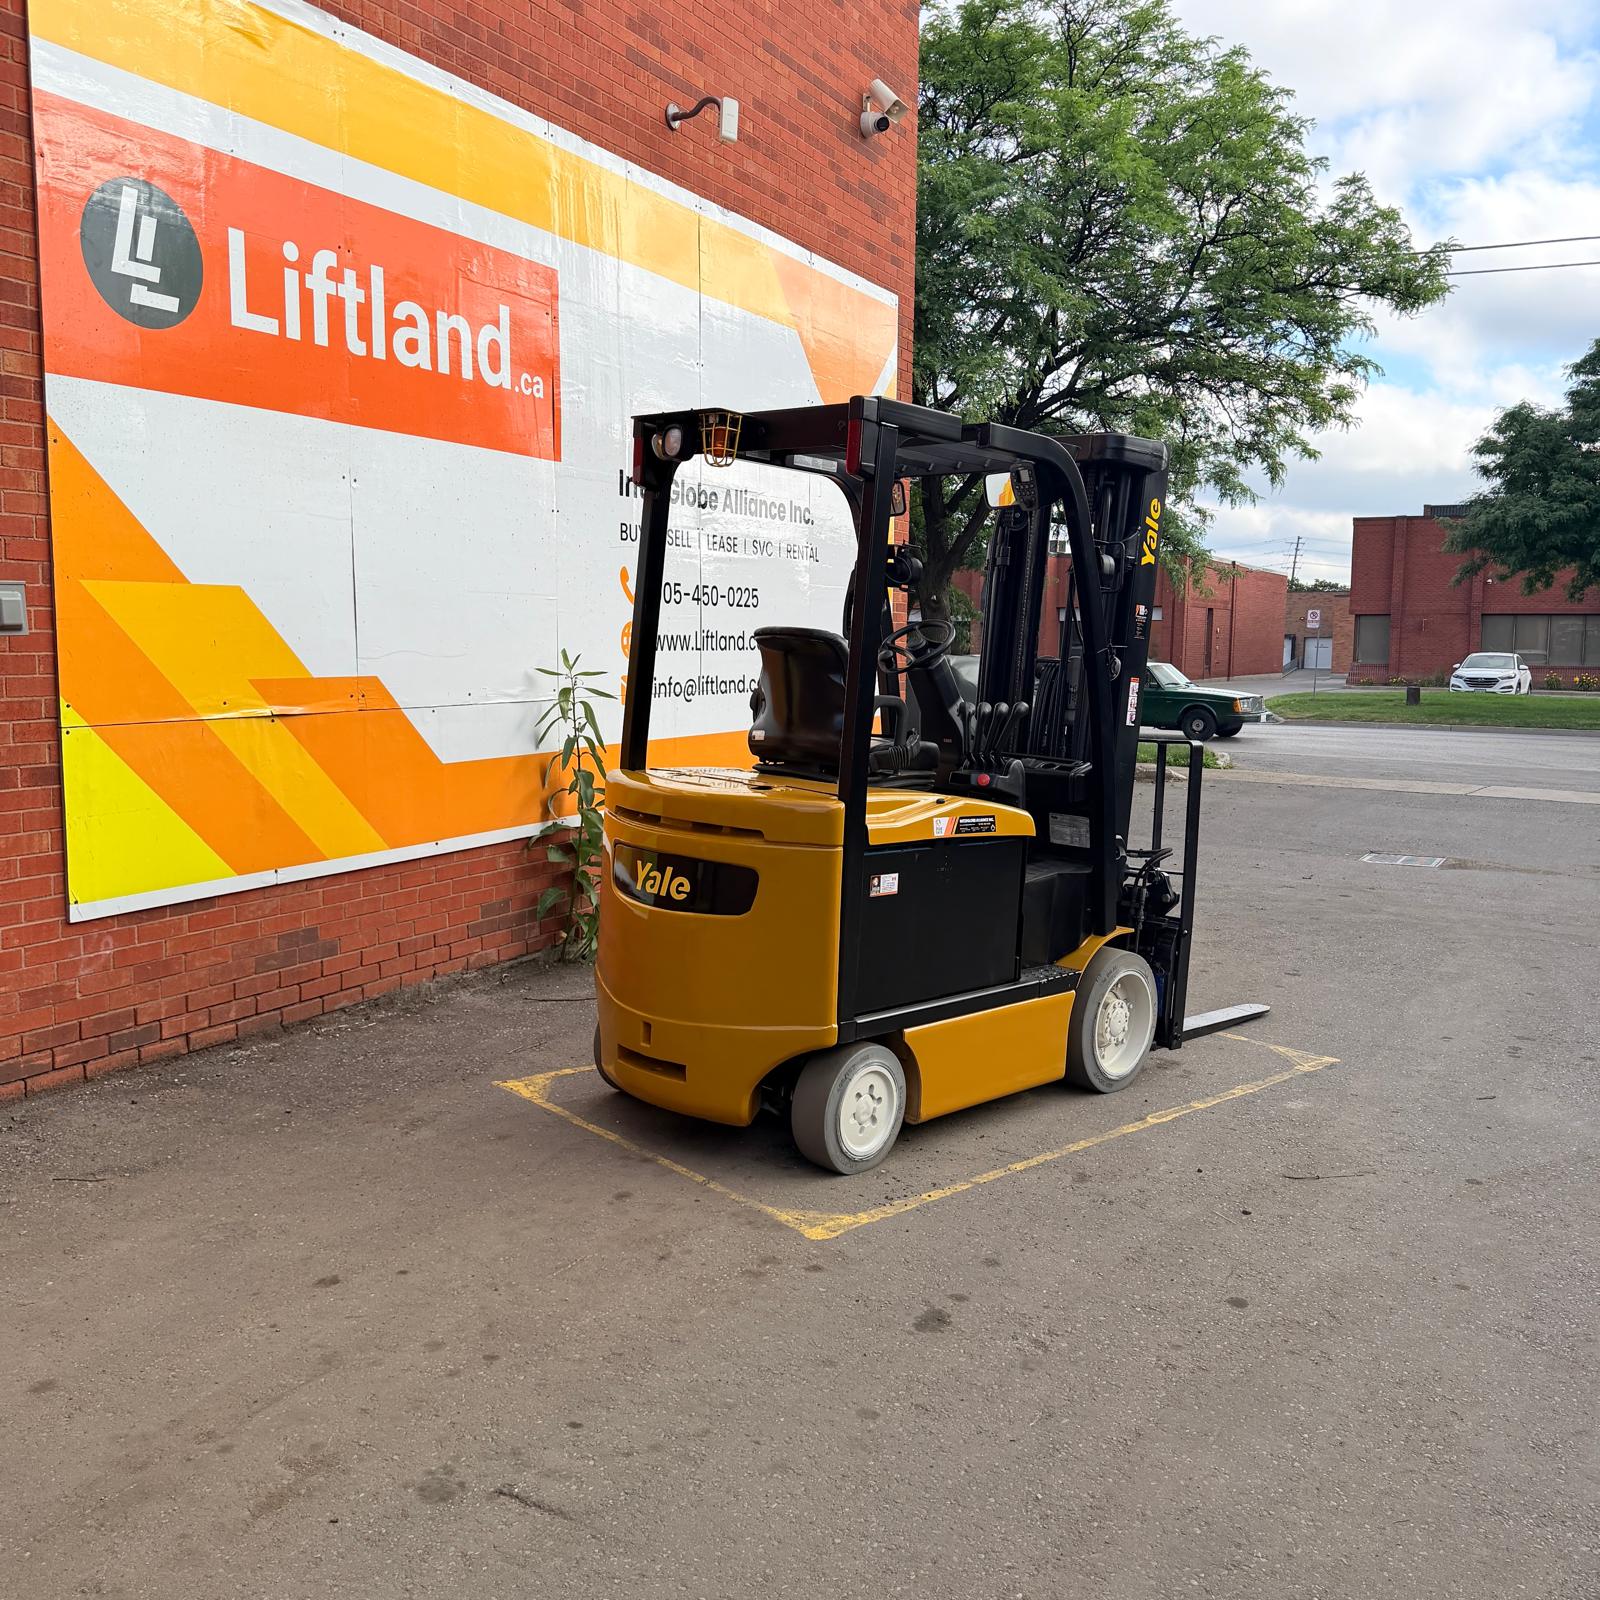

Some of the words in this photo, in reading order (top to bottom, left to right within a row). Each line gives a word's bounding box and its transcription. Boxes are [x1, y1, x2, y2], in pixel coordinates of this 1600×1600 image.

[722, 489, 787, 521] Alliance
[789, 500, 815, 526] Inc.
[620, 522, 642, 542] BU
[667, 528, 692, 548] SELL
[706, 533, 738, 554] LEASE
[752, 539, 774, 557] SVC
[786, 542, 820, 563] RENTAL
[1140, 498, 1162, 566] Yale
[663, 581, 760, 608] 05-450-0225
[655, 629, 759, 652] www.Liftland.c
[636, 860, 691, 901] Yale
